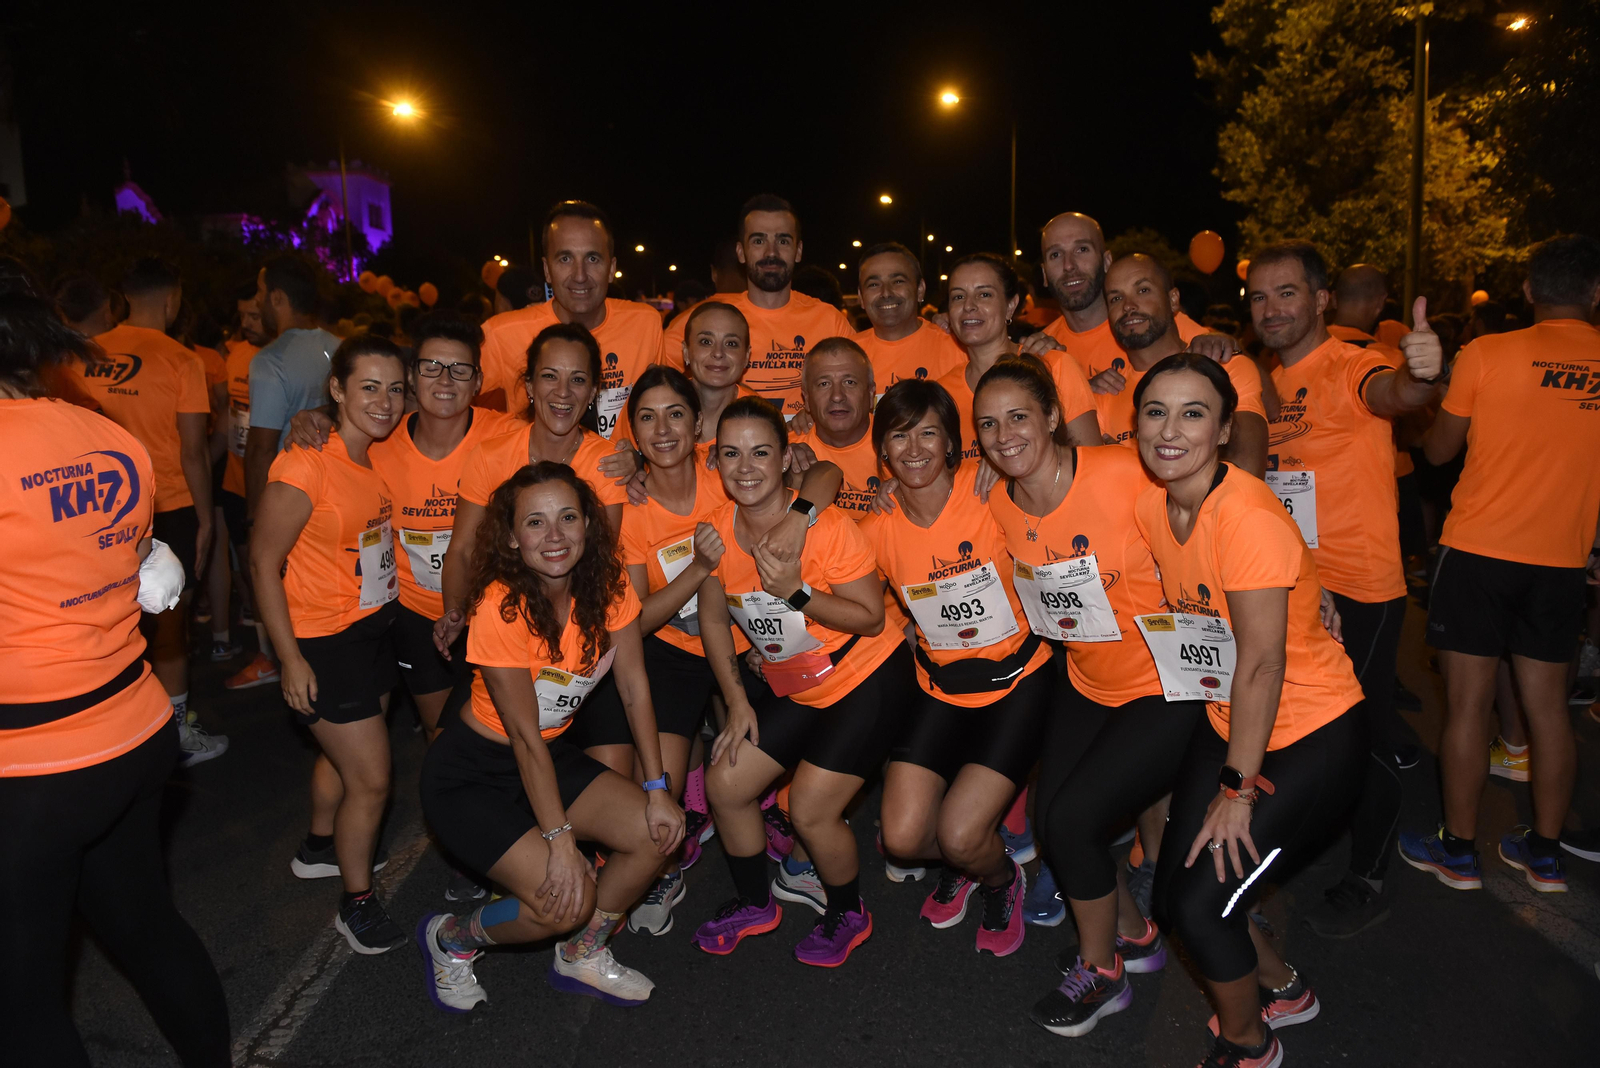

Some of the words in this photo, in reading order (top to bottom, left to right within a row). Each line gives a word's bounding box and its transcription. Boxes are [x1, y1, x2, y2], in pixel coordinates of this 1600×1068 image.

[746, 361, 786, 369] SEVILLA
[1531, 360, 1590, 372] NOCTURNA
[107, 387, 139, 396] SEVILLA
[20, 462, 94, 491] NOCTURNA
[402, 506, 448, 517] SEVILLA
[928, 558, 982, 581] NOCTURNA
[1040, 590, 1083, 609] 4998
[940, 598, 985, 621] 4993
[748, 618, 783, 635] 4987
[1180, 643, 1222, 668] 4997
